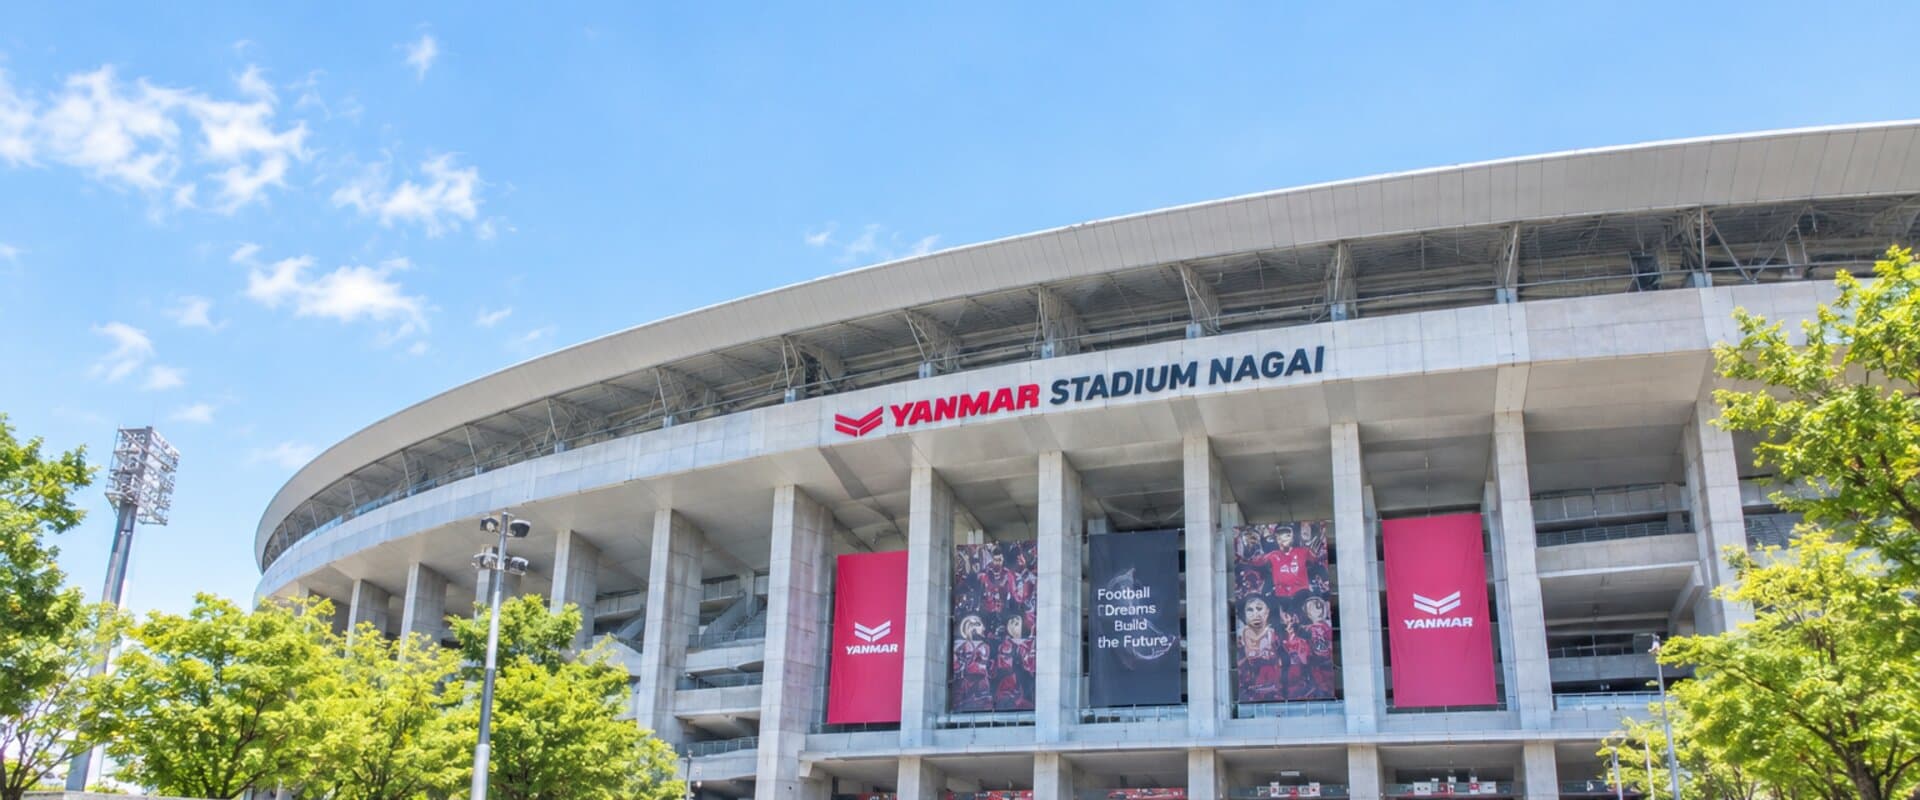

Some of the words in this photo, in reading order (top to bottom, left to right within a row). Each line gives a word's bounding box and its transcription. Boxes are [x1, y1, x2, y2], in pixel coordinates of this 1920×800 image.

[890, 384, 1040, 427] YANMAR
[1049, 361, 1198, 406] STADIUM
[1208, 346, 1326, 386] NAGAI
[1098, 586, 1150, 600] Football
[1114, 618, 1148, 632] Build
[1403, 617, 1473, 629] YANMAR
[845, 643, 899, 655] YANMAR
[1098, 636, 1120, 649] the
